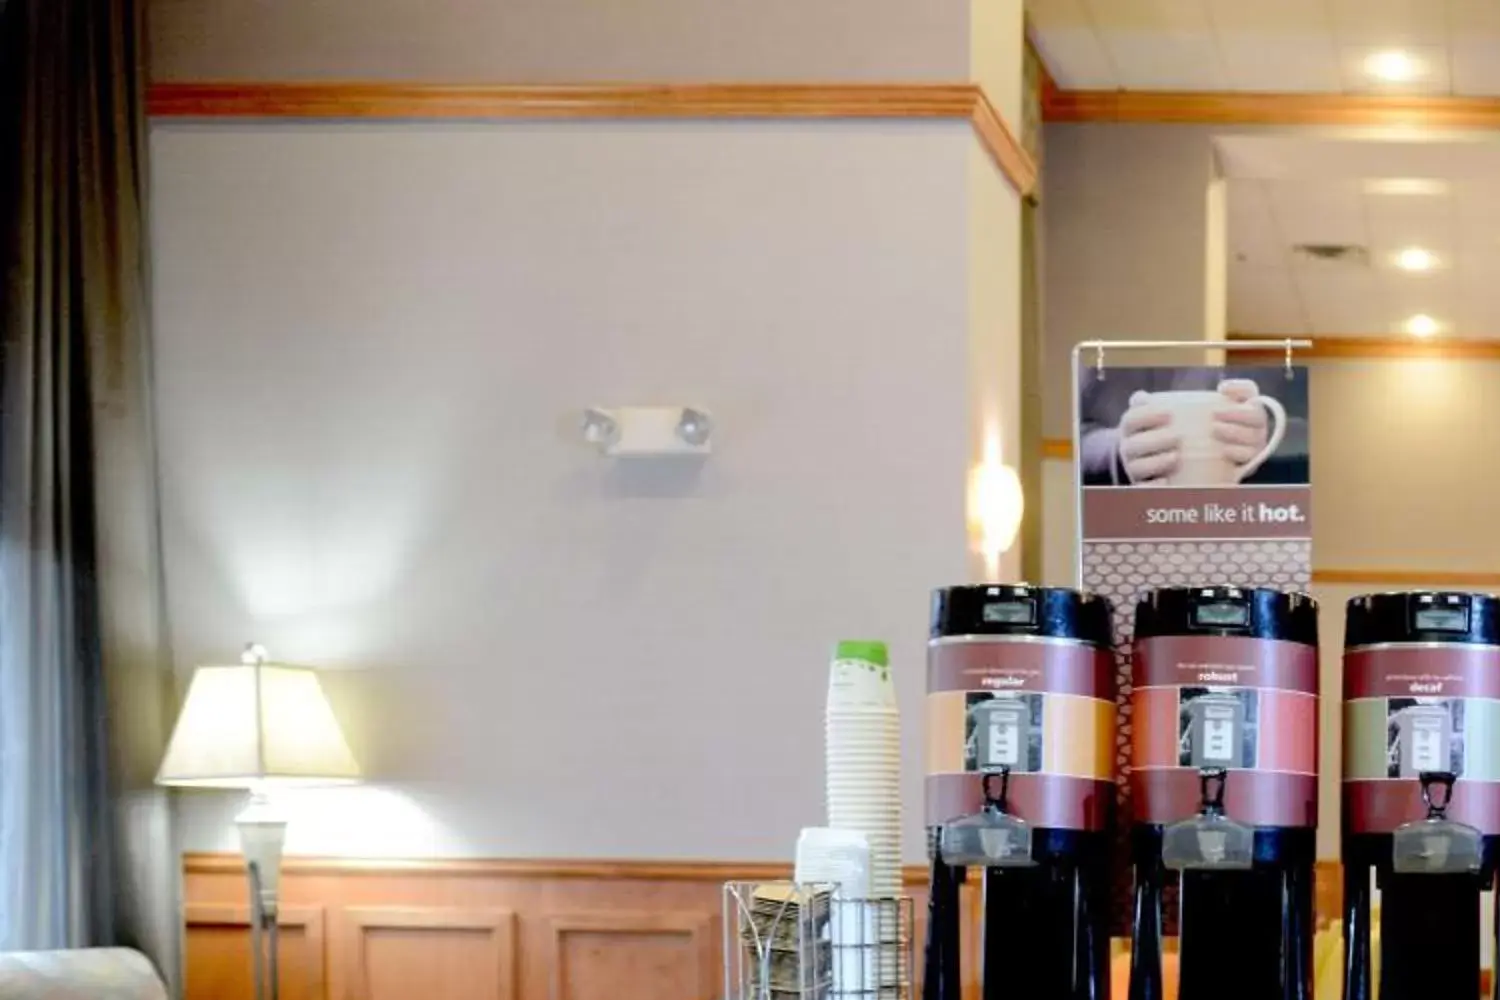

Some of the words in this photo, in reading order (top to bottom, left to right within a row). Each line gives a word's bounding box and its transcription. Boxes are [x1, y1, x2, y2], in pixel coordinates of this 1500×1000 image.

[1146, 507, 1199, 523] some
[1204, 503, 1237, 523] like
[1242, 503, 1255, 523] it
[1259, 502, 1306, 523] hot.
[981, 676, 1025, 689] regular
[1198, 671, 1238, 683] robust
[1409, 681, 1443, 693] decaf
